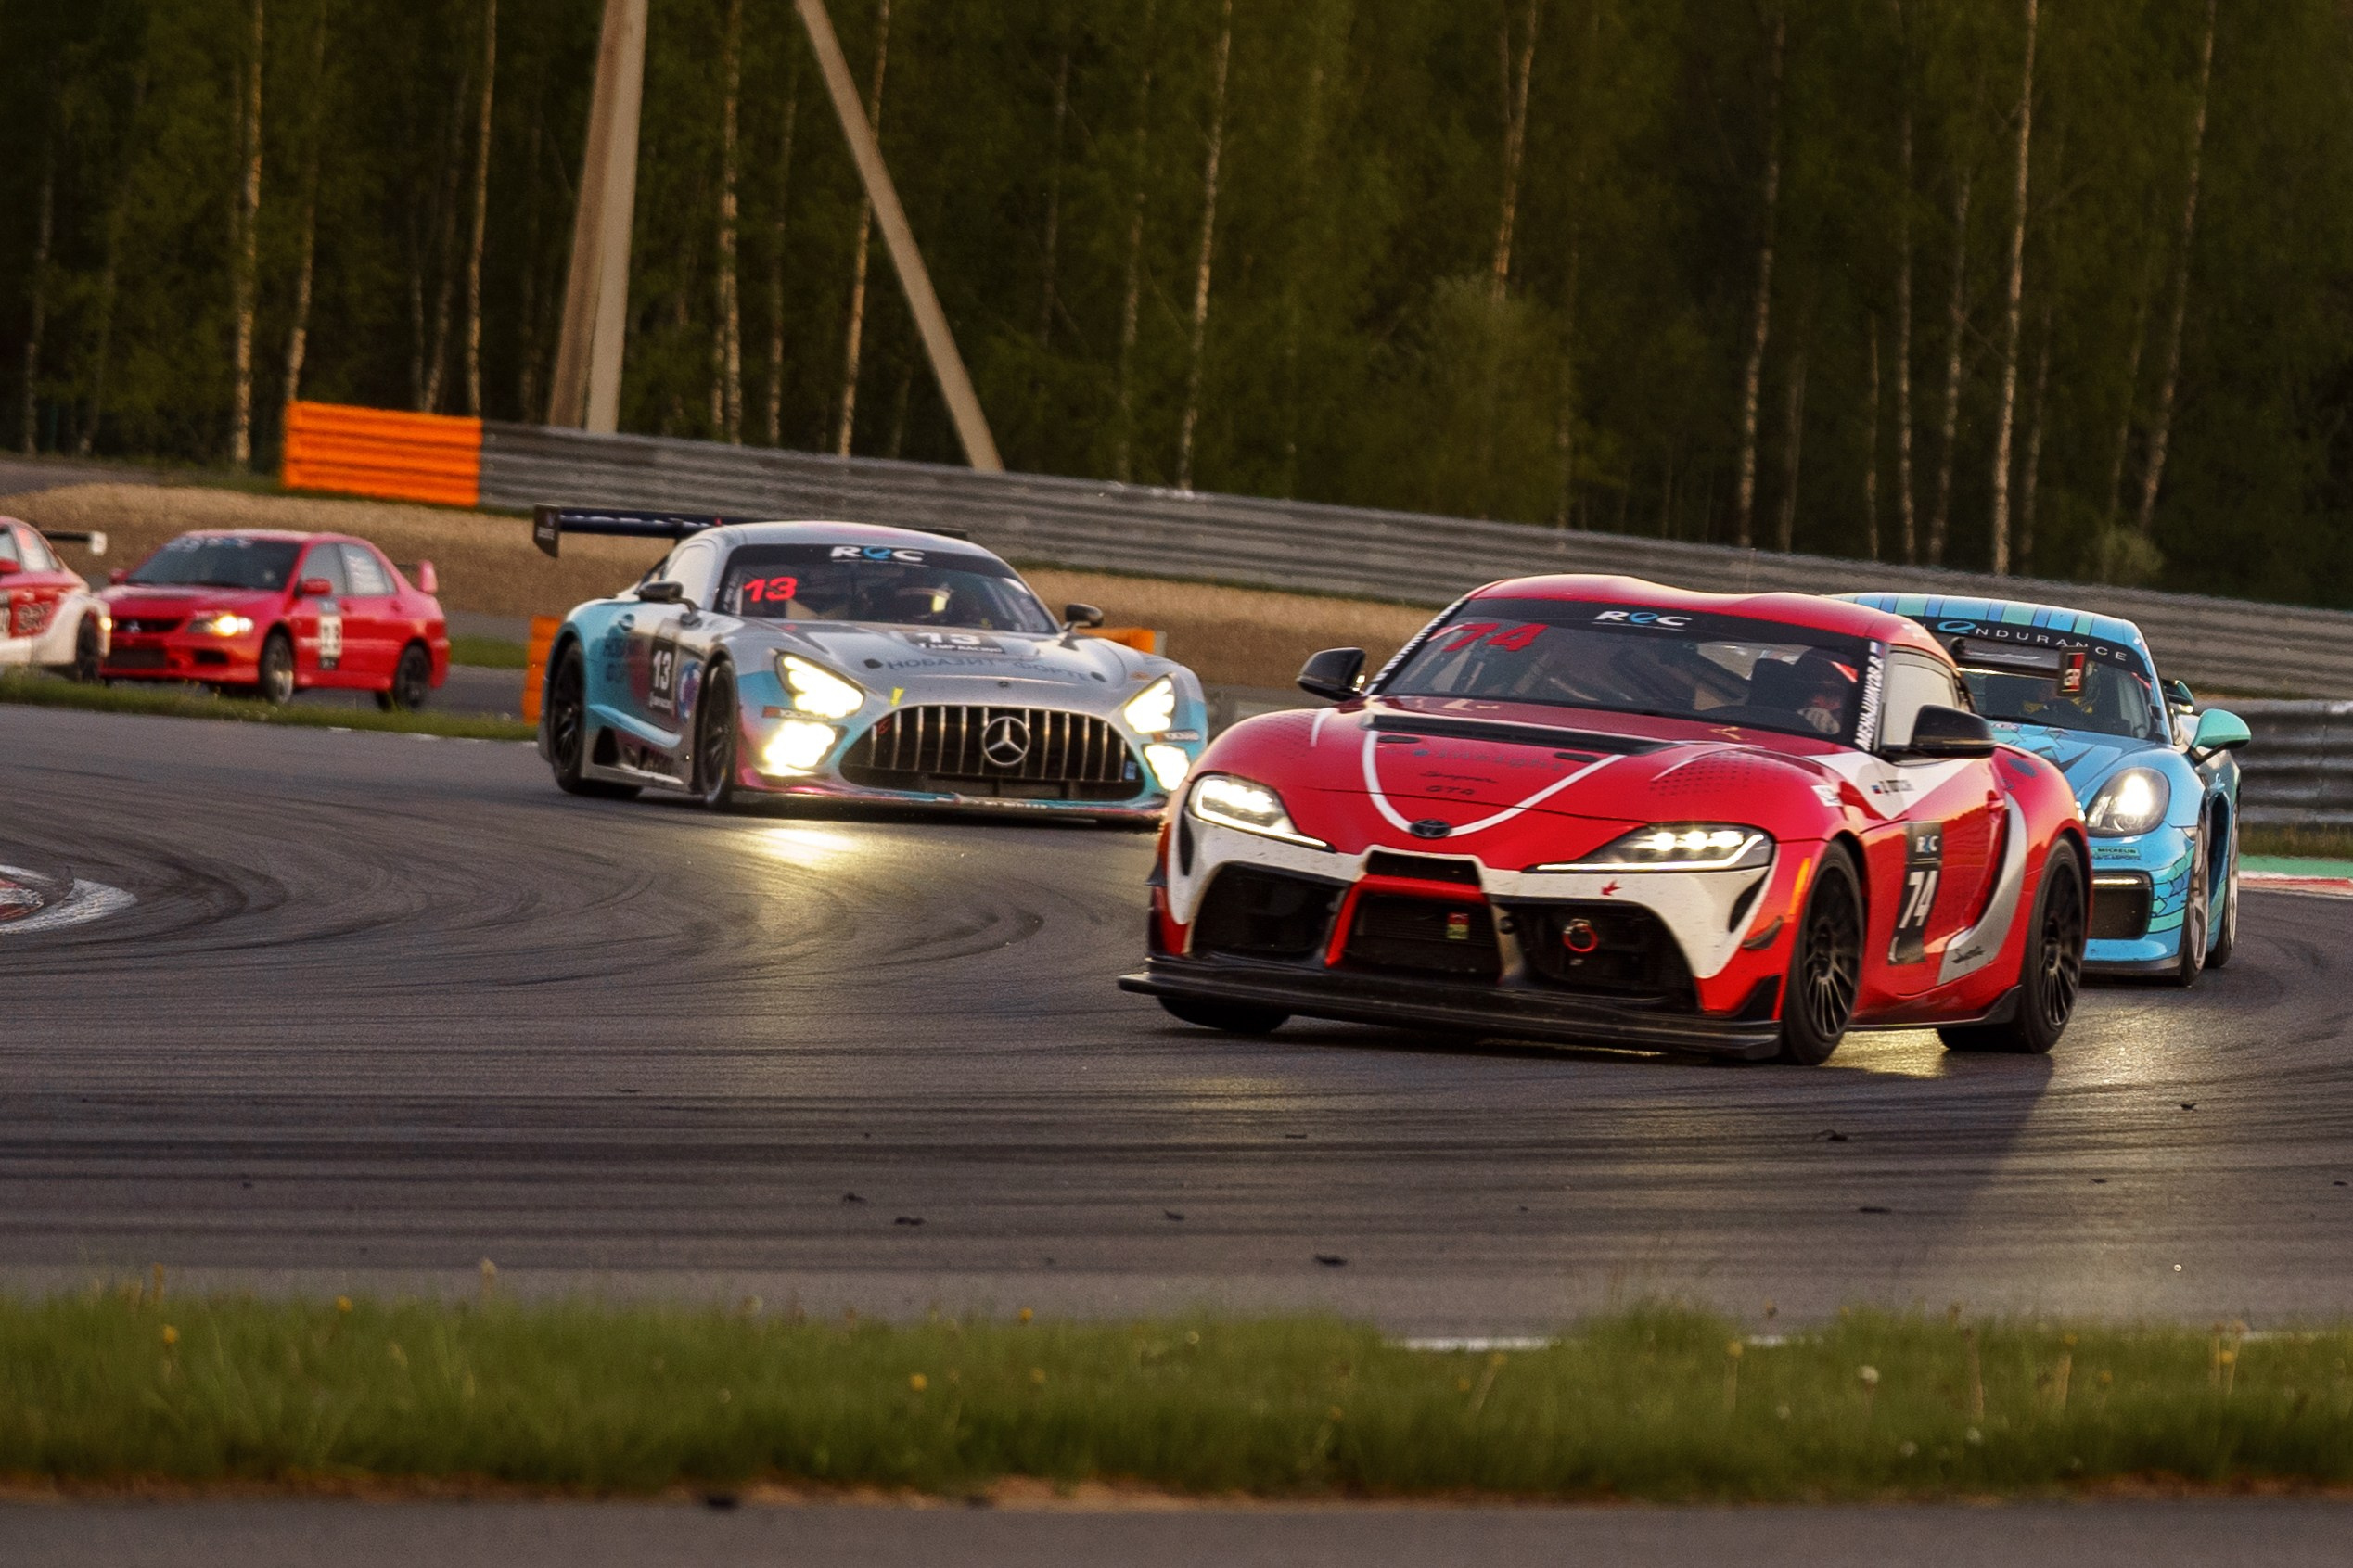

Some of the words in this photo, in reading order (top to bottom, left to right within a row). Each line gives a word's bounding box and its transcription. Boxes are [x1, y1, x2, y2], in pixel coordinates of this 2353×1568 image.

[743, 576, 798, 603] 13
[915, 632, 981, 645] 13
[1441, 622, 1550, 652] 74
[652, 649, 673, 690] 13
[1899, 870, 1939, 929] 74
